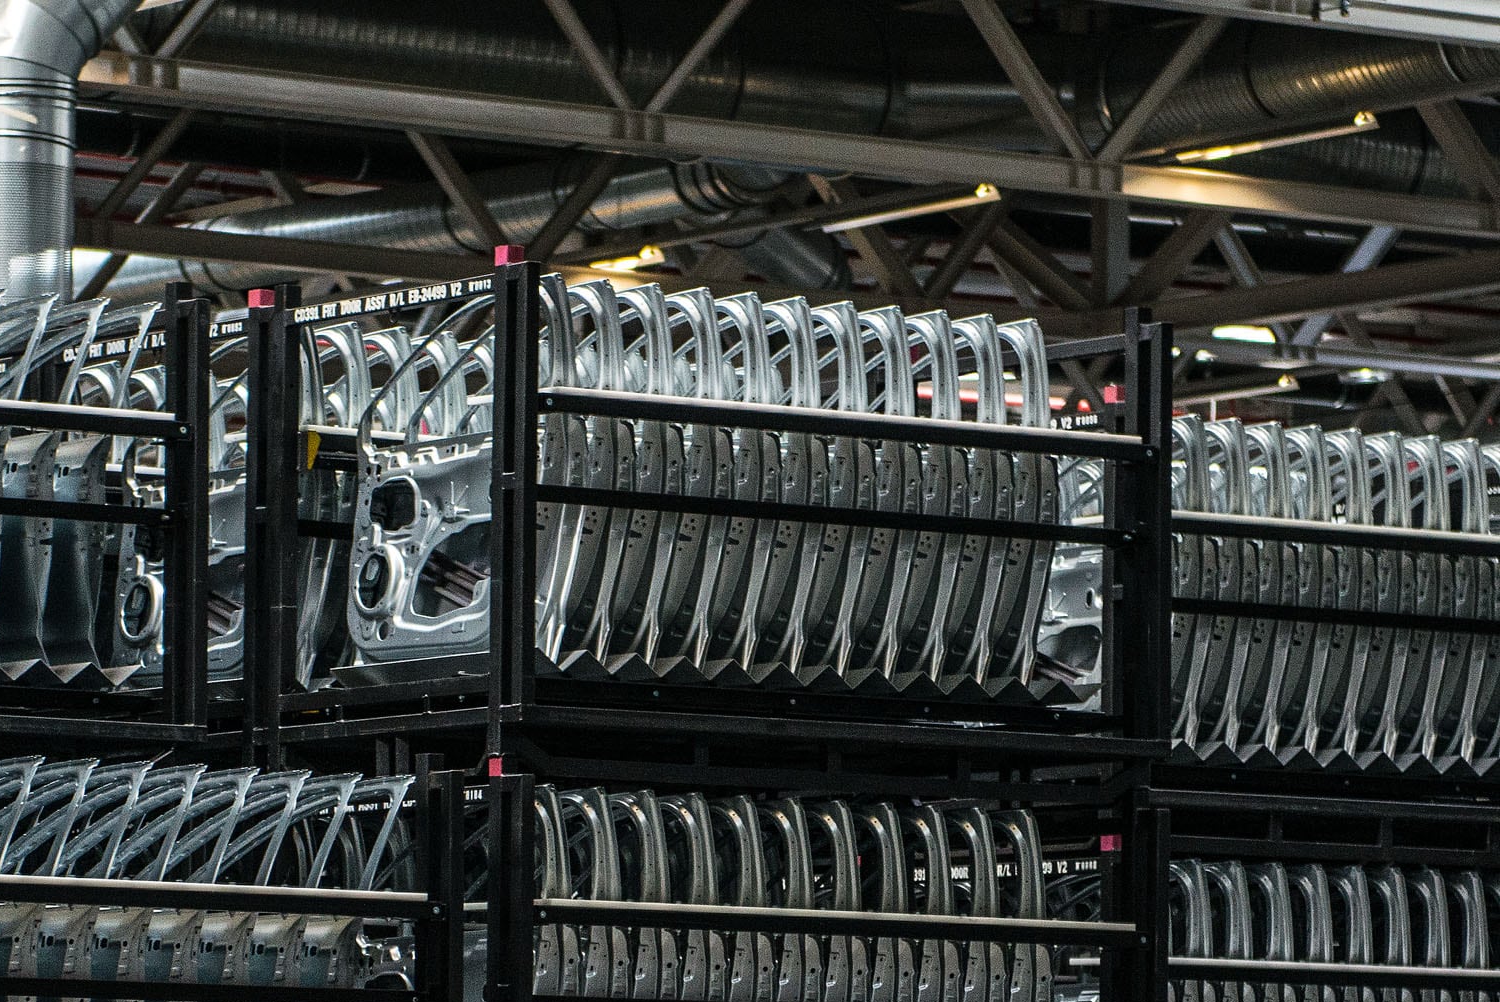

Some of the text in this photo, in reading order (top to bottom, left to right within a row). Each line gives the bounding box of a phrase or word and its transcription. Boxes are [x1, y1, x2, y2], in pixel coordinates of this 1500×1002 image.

[294, 307, 319, 323] CD391
[322, 304, 337, 319] FRT
[340, 299, 362, 316] DOOR
[365, 295, 387, 312] ASSY
[389, 292, 405, 307] R/L
[408, 284, 446, 304] EB-24499
[451, 283, 462, 297] V2
[997, 863, 1011, 877] R/L
[1057, 861, 1068, 875] V2
